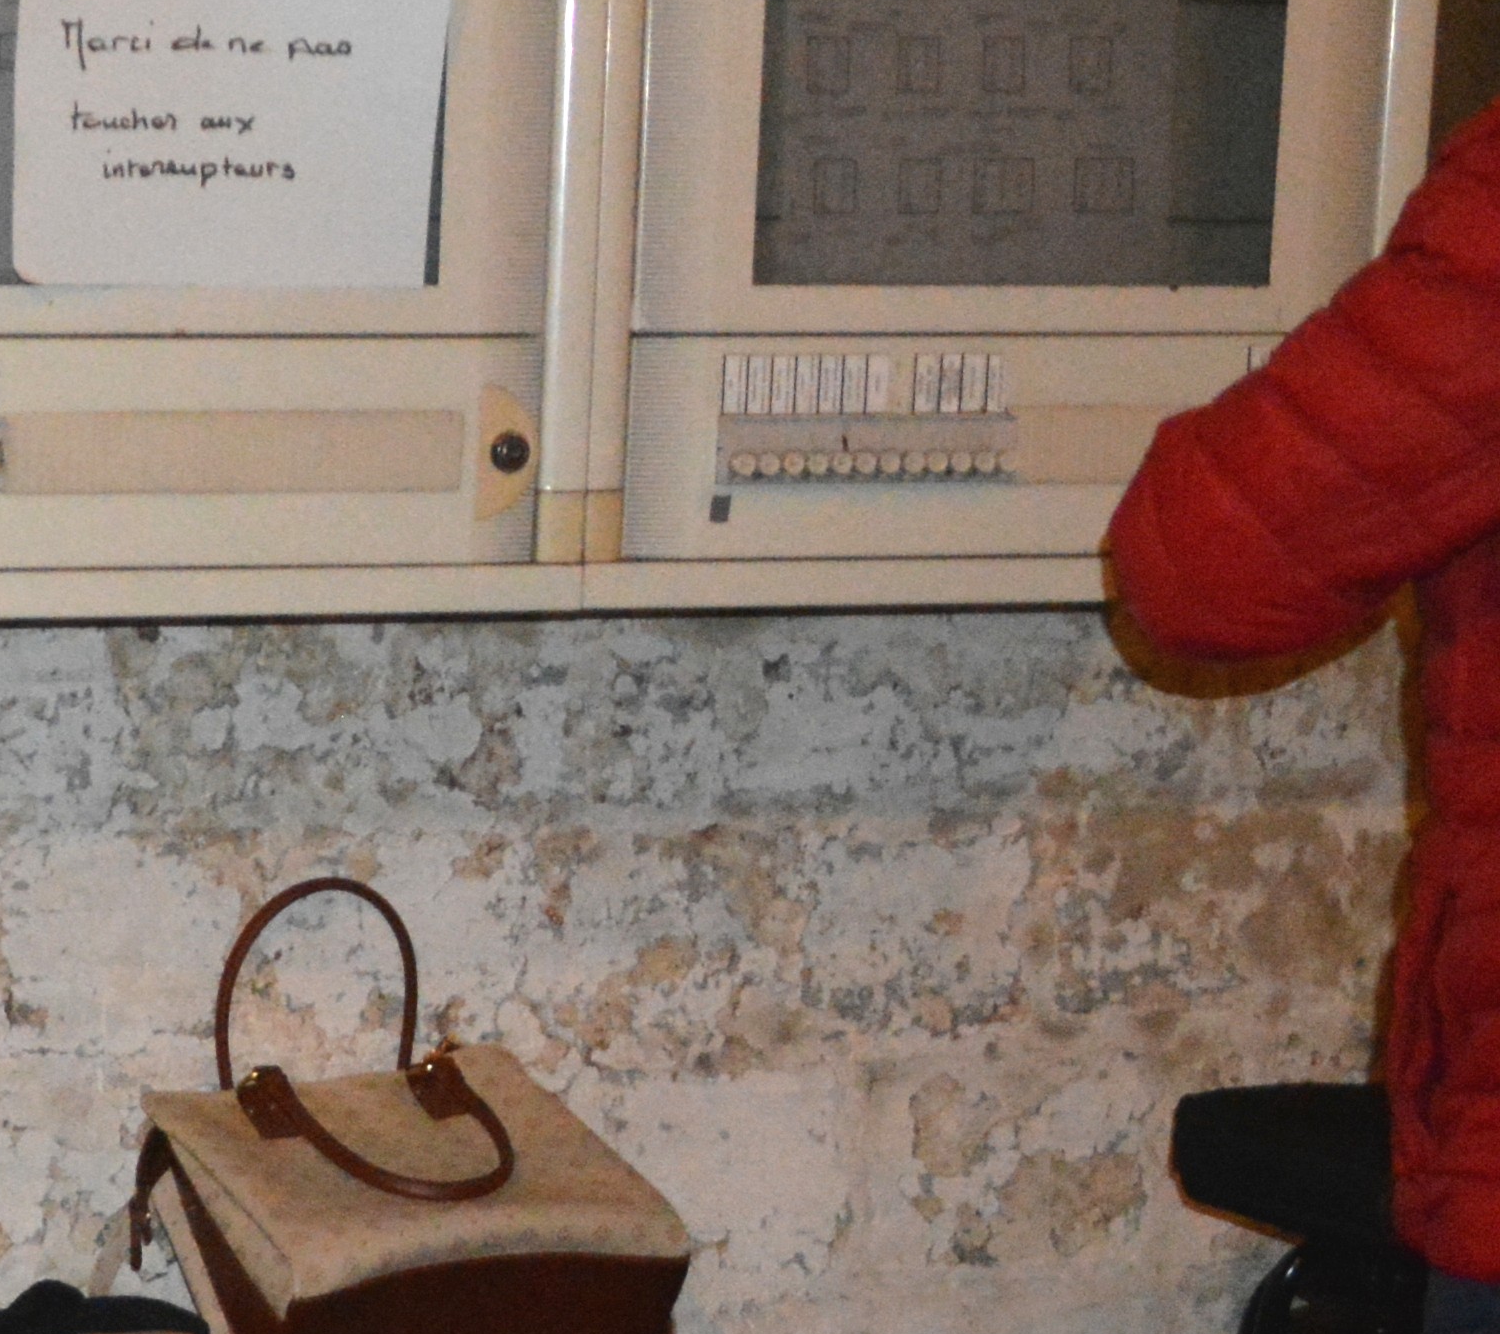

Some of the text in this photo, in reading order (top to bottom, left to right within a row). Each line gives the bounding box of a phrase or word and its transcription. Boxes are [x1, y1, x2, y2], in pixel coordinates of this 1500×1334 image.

[61, 17, 352, 71] Merci de ne pas
[71, 100, 257, 135] toucher aux
